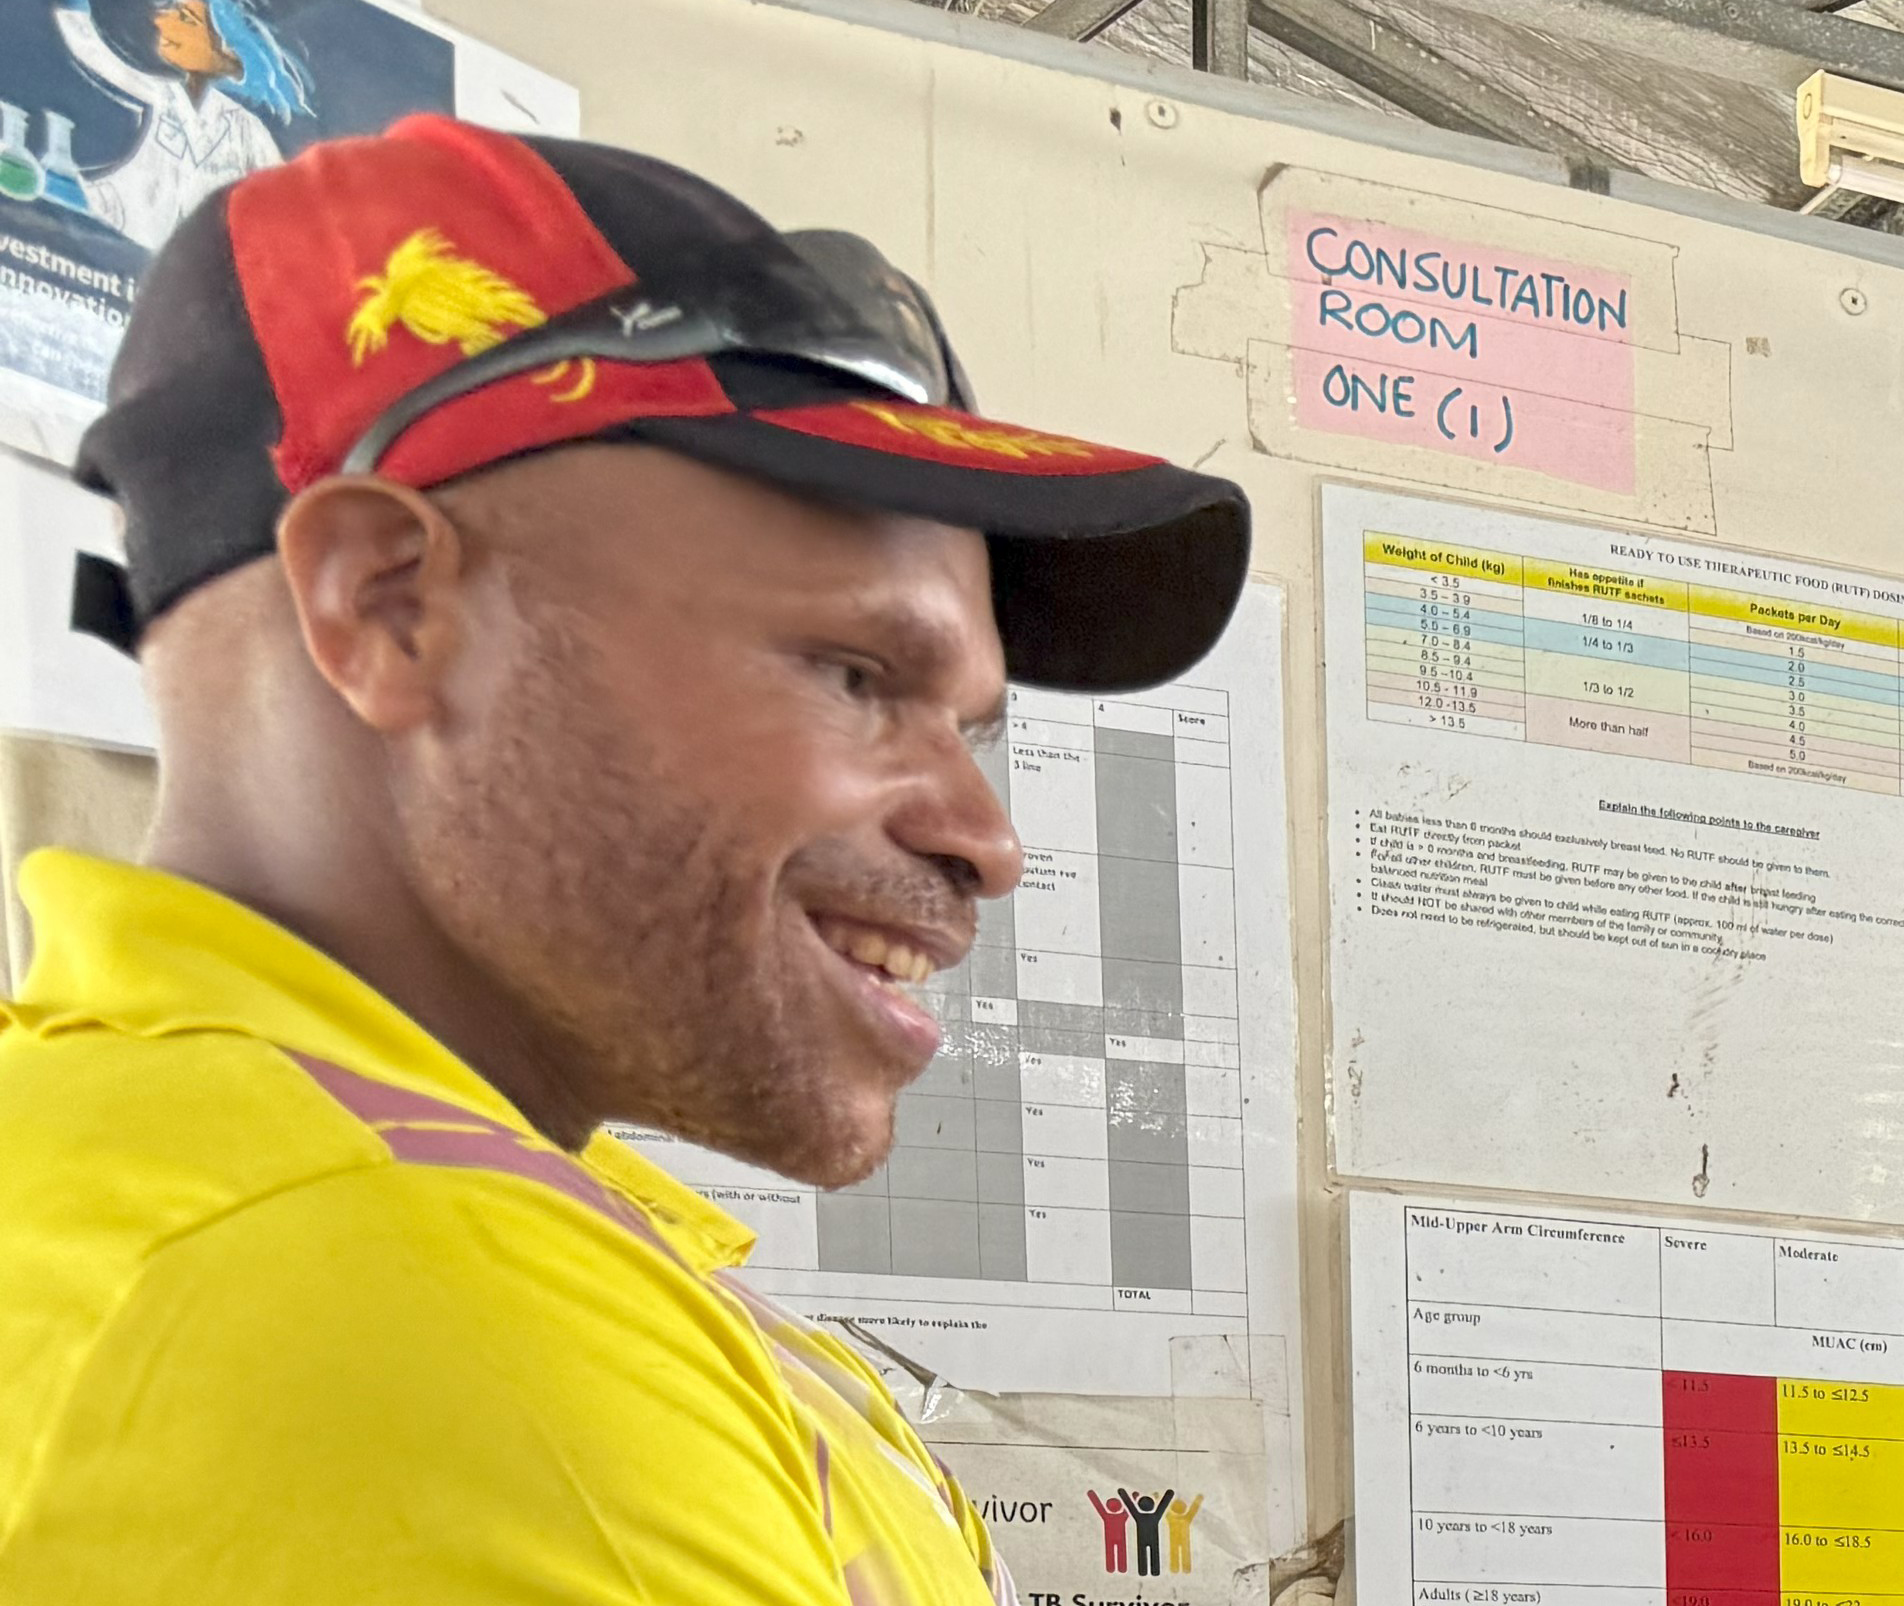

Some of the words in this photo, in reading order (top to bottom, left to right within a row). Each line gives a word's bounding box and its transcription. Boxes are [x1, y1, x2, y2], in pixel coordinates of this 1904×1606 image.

[1306, 226, 1627, 330] CONSULTATION
[1318, 291, 1478, 358] ROOM
[1323, 365, 1413, 418] ONE
[1382, 542, 1425, 561] Weight
[1431, 550, 1442, 562] of
[1446, 551, 1477, 570] Child
[1481, 558, 1504, 576] (kg)
[1610, 544, 1655, 562] READY
[1656, 551, 1675, 564] TO
[1678, 556, 1701, 568] USE
[1706, 559, 1791, 584] THERAPEUTIC
[1795, 575, 1828, 591] FOOD
[1831, 581, 1870, 599] (RUTF)
[1750, 602, 1794, 620] Packets
[1797, 611, 1816, 626] per
[1820, 615, 1840, 630] Day
[1582, 635, 1600, 649] 1/4
[1602, 639, 1613, 651] to
[1616, 640, 1634, 655] 1/3
[1787, 645, 1806, 659] 1.5
[1787, 660, 1806, 674] 2.0
[1568, 715, 1598, 733] More
[1600, 719, 1624, 735] than
[1627, 723, 1650, 739] half
[1020, 952, 1038, 963] Yes
[975, 999, 994, 1011] Yes
[1108, 1037, 1127, 1048] Yes
[1411, 1214, 1488, 1235] Mid-Upper
[1491, 1221, 1523, 1236] Arm
[1526, 1224, 1626, 1244] Circumference
[1664, 1235, 1707, 1251] Severe
[1779, 1245, 1839, 1262] Moderate
[1117, 1289, 1152, 1301] TOTAL
[1412, 1307, 1440, 1324] Age
[1443, 1312, 1481, 1327] group
[1812, 1335, 1857, 1350] MUAC
[1859, 1338, 1888, 1354] (cm)
[1413, 1360, 1422, 1373] 6
[1426, 1363, 1473, 1377] months
[1476, 1366, 1490, 1377] to
[1493, 1365, 1511, 1379] <6
[1513, 1370, 1534, 1383] yrs
[1782, 1383, 1810, 1399] 11.5
[1812, 1388, 1826, 1400] to
[1830, 1387, 1869, 1403] ≤12.5
[1414, 1420, 1423, 1433] 6
[1426, 1423, 1461, 1437] years
[1464, 1425, 1478, 1436] to
[1481, 1424, 1506, 1438] <10
[1509, 1428, 1543, 1441] years
[1783, 1440, 1811, 1455] 13.5
[1813, 1444, 1827, 1456] to
[1830, 1444, 1871, 1461] ≤14.5
[1419, 1517, 1434, 1531] 10
[1436, 1522, 1471, 1535] years
[1474, 1522, 1488, 1533] to
[1490, 1520, 1516, 1535] <18
[1519, 1524, 1553, 1538] years
[1785, 1532, 1812, 1547] 16.0
[1815, 1535, 1829, 1547] to
[1833, 1535, 1871, 1549] ≤18.5
[1418, 1587, 1461, 1601] Adults
[1502, 1590, 1542, 1605] years)
